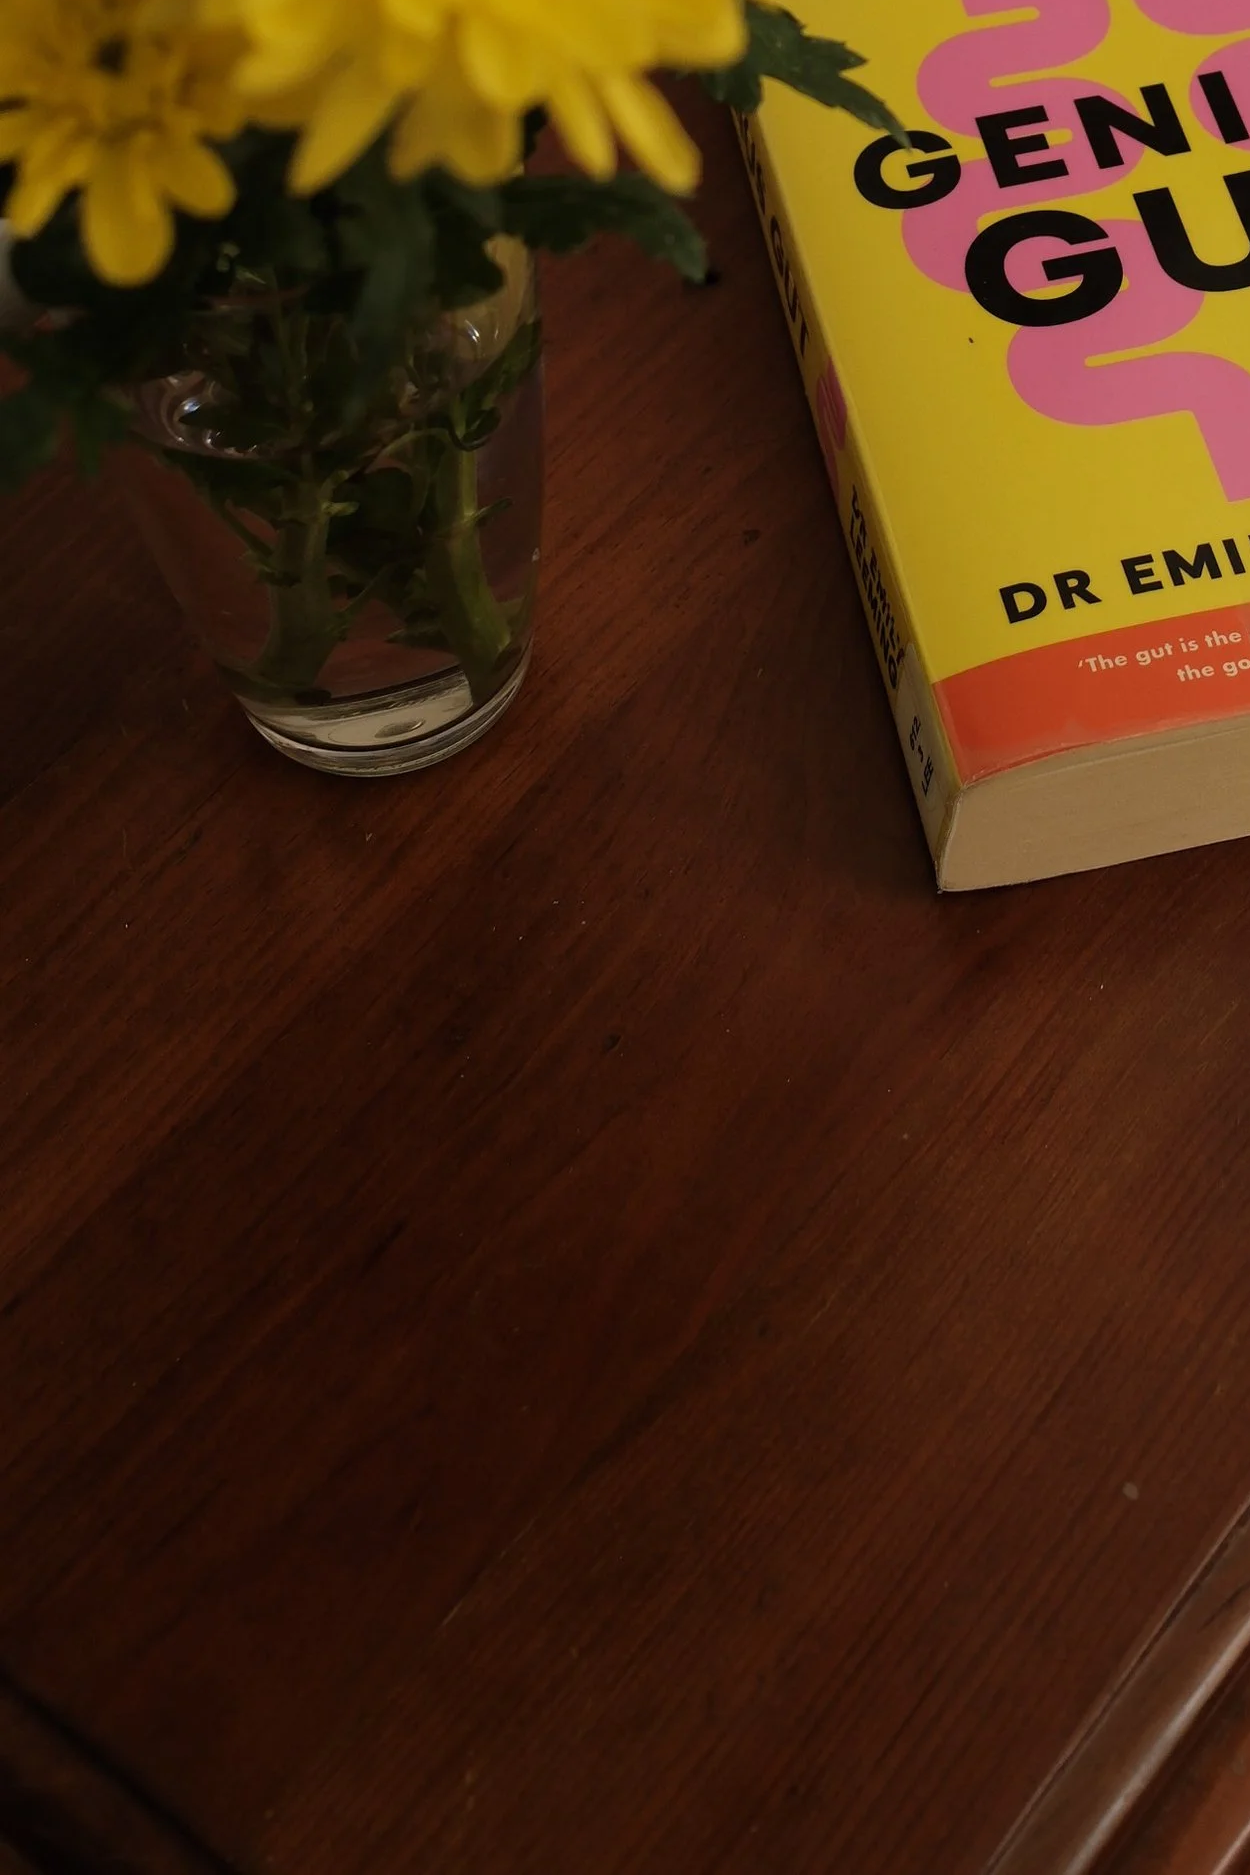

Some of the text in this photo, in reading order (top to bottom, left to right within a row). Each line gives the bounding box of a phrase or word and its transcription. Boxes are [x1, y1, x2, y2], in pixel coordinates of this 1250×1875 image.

[849, 512, 898, 690] LEEMING
[999, 569, 1103, 625] DR
[1135, 642, 1174, 667] gut
[1180, 638, 1199, 653] is
[1204, 630, 1243, 649] the
[1177, 665, 1216, 682] the
[921, 756, 935, 798] LEE
